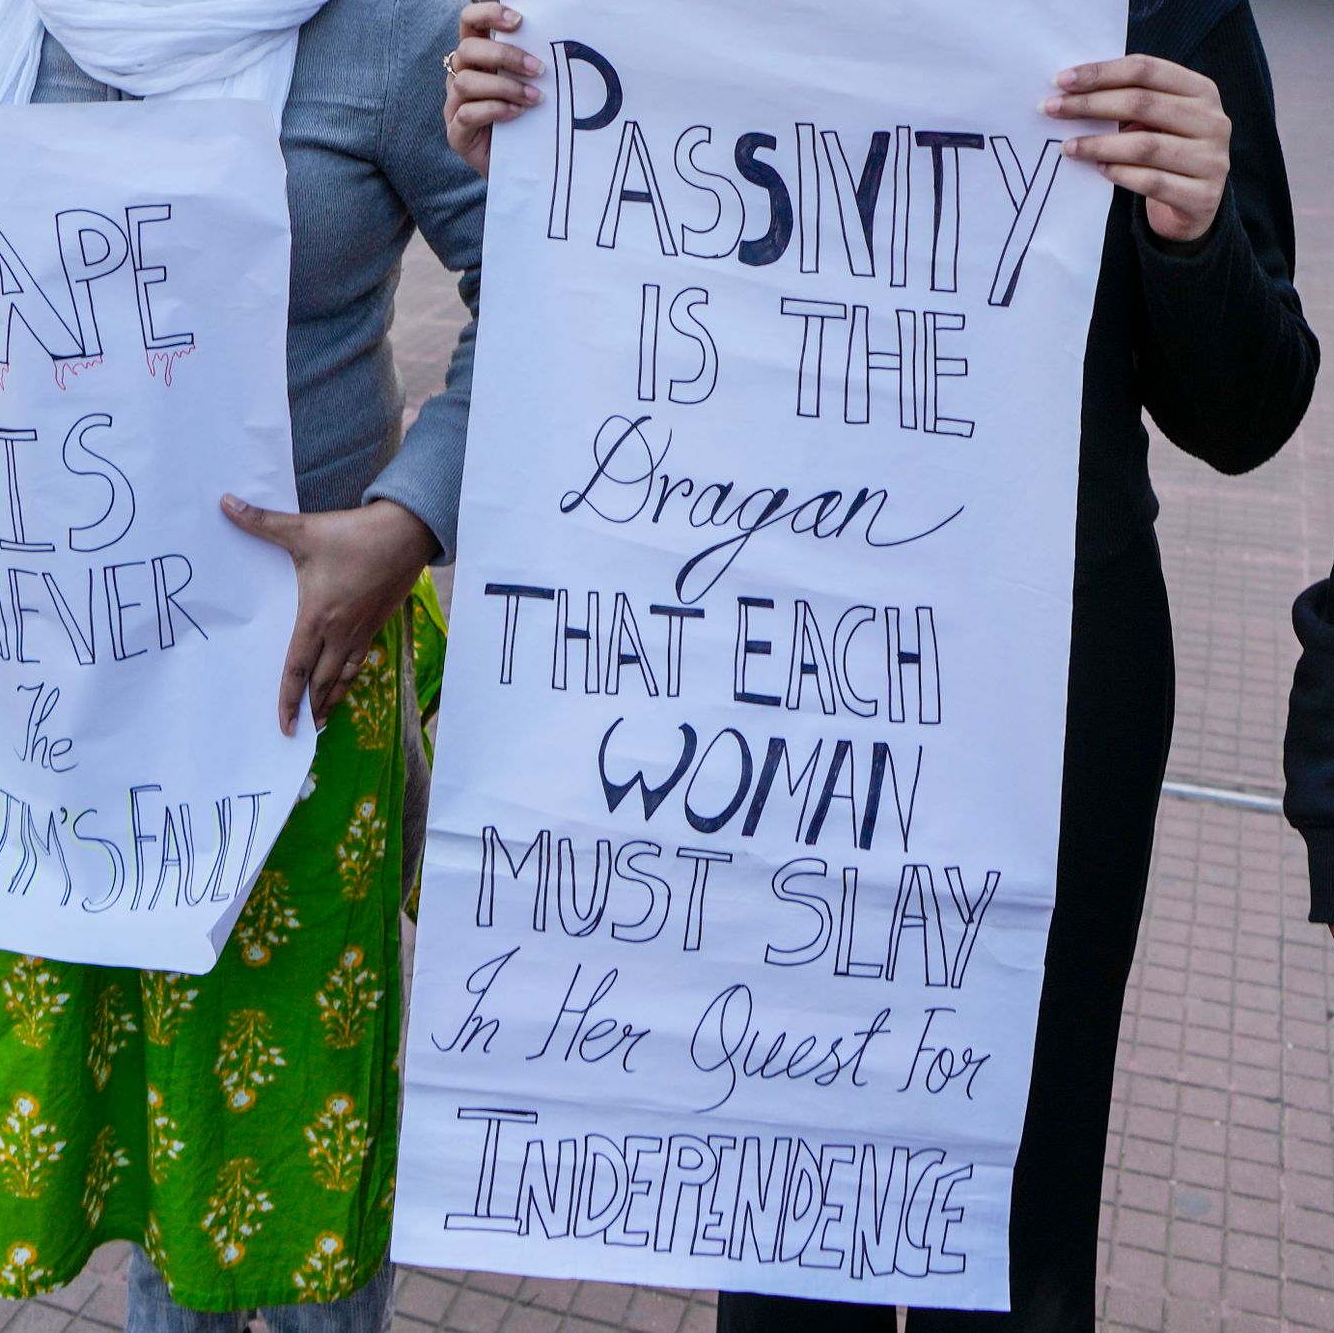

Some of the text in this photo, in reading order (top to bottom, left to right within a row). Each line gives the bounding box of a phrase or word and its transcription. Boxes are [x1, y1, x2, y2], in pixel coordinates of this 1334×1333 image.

[637, 284, 975, 438] IS THE
[17, 681, 78, 773] The
[485, 583, 941, 725] THAT EACH
[131, 784, 271, 910] FAULT
[598, 717, 922, 853] WOMAN
[476, 826, 1001, 989] MUST SLAY
[431, 946, 991, 1114] In Her Quest For
[444, 1108, 973, 1280] INDEPENDENCE
